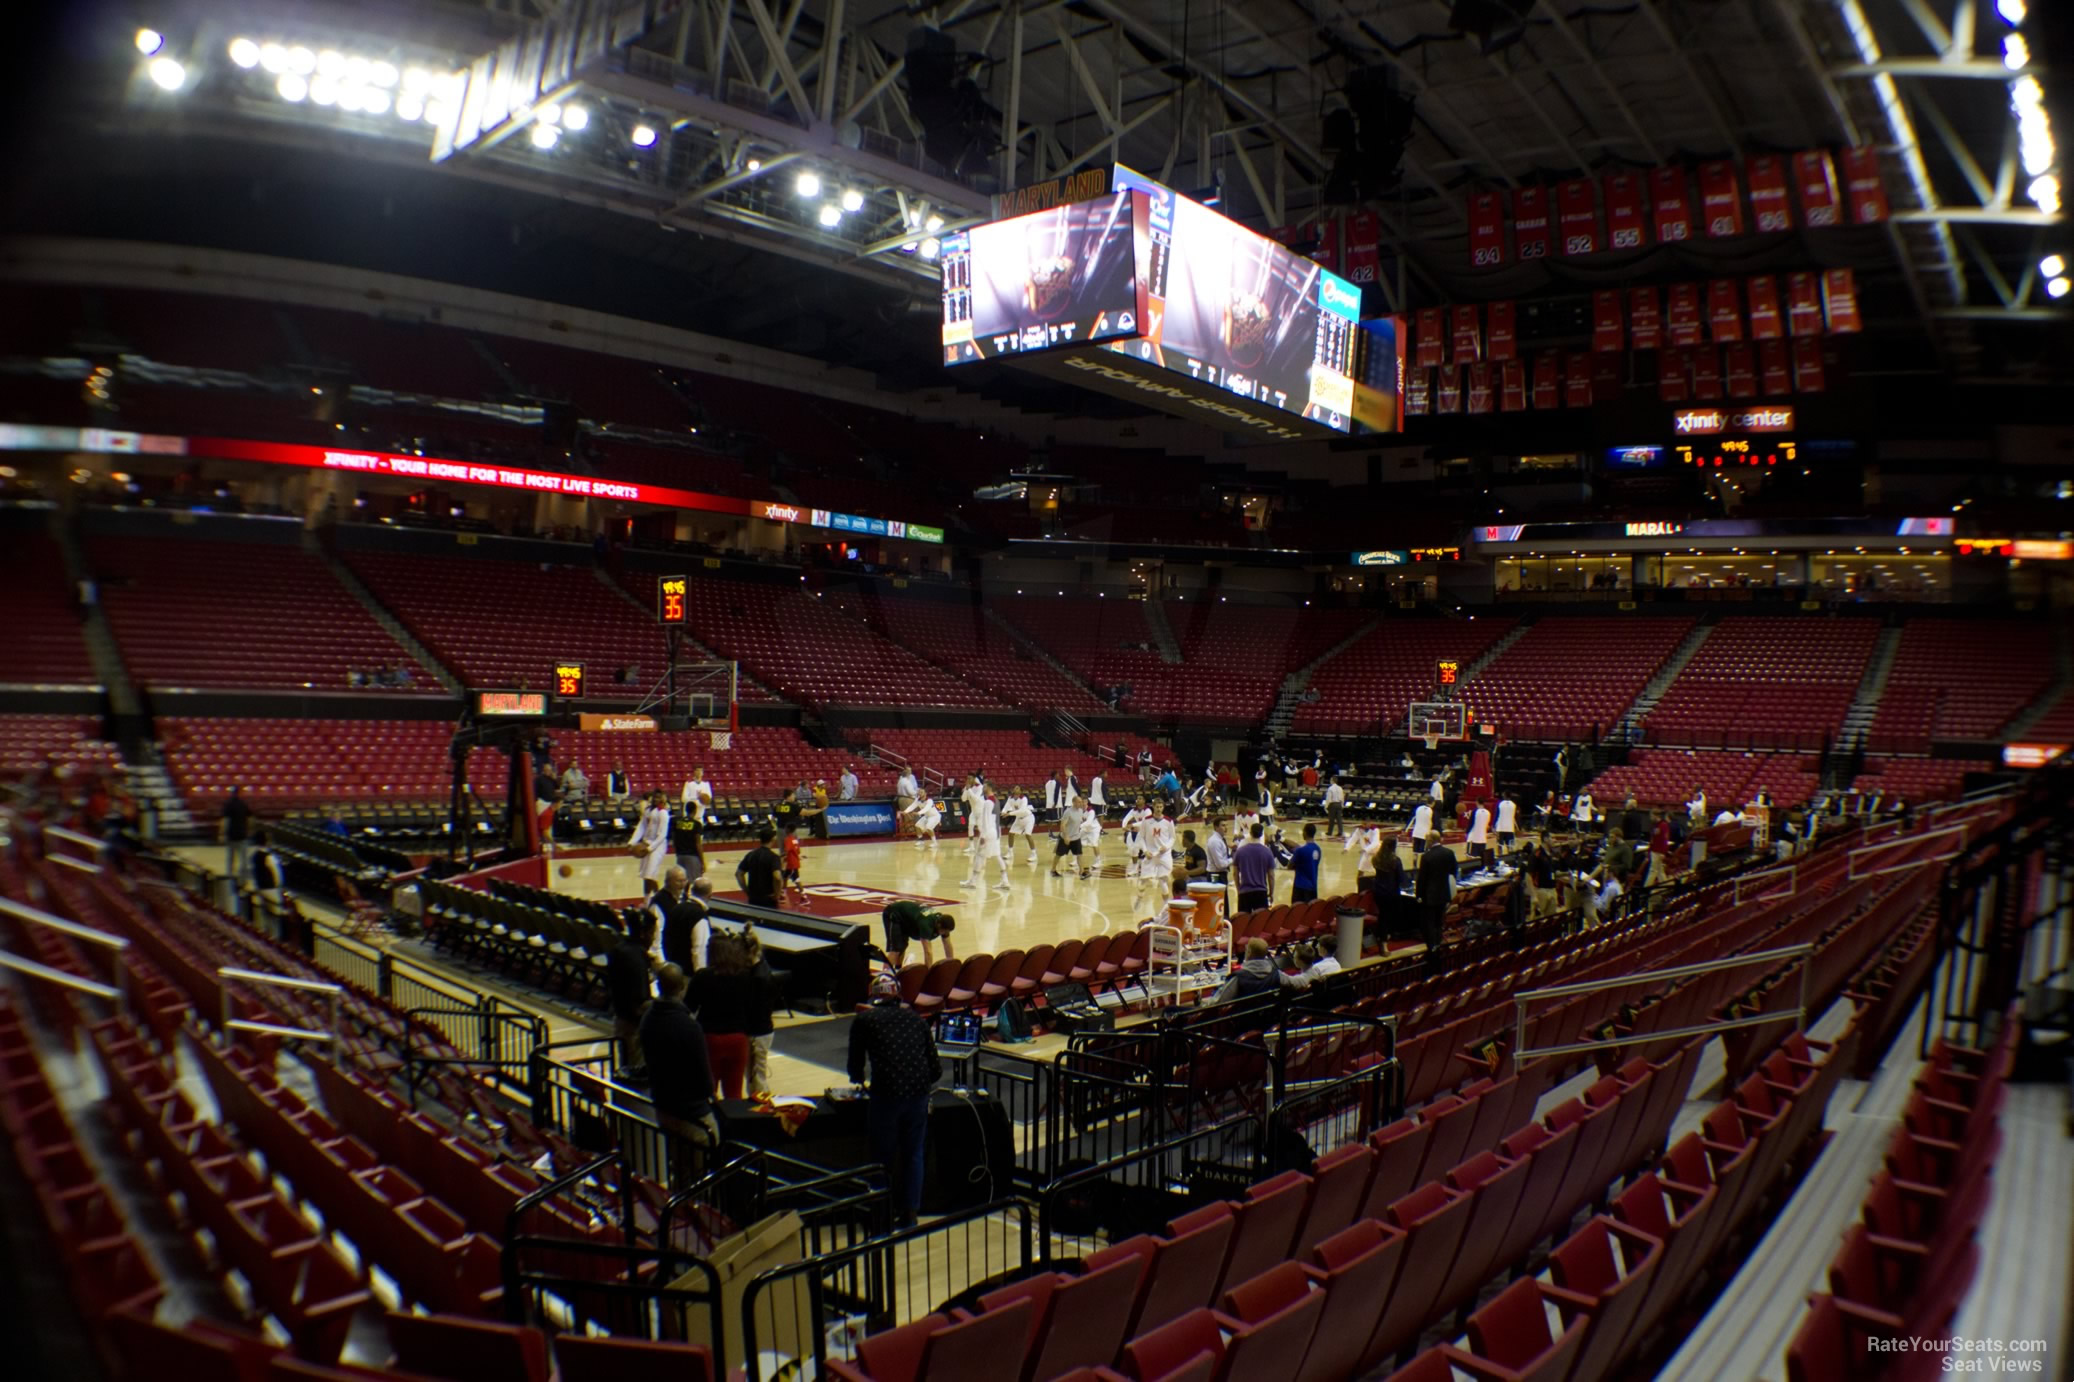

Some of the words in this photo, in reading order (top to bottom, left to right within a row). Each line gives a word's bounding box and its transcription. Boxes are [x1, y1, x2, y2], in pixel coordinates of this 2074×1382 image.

[1000, 168, 1105, 216] MARYLAND
[1567, 235, 1593, 254] 52
[1614, 228, 1640, 247] 55
[1475, 247, 1500, 265] 34
[1522, 241, 1545, 259] 25
[1352, 265, 1374, 282] 42
[1676, 412, 1728, 432] xfinity
[1732, 410, 1791, 426] center
[324, 452, 378, 469] XFINITY
[390, 459, 426, 475] YOUR
[429, 463, 467, 478] HOME
[469, 467, 497, 482] FOR
[499, 471, 524, 485] THE
[526, 475, 560, 489] MOST
[563, 479, 590, 492] LIVE
[592, 483, 638, 498] SPORTS
[766, 504, 798, 521] xfinity
[1487, 527, 1497, 539] M
[665, 595, 682, 619] 35
[1441, 670, 1455, 682] 35
[560, 679, 576, 694] 35
[827, 816, 839, 824] The
[840, 814, 877, 825] Washington
[878, 814, 892, 823] Post
[1153, 827, 1161, 837] M
